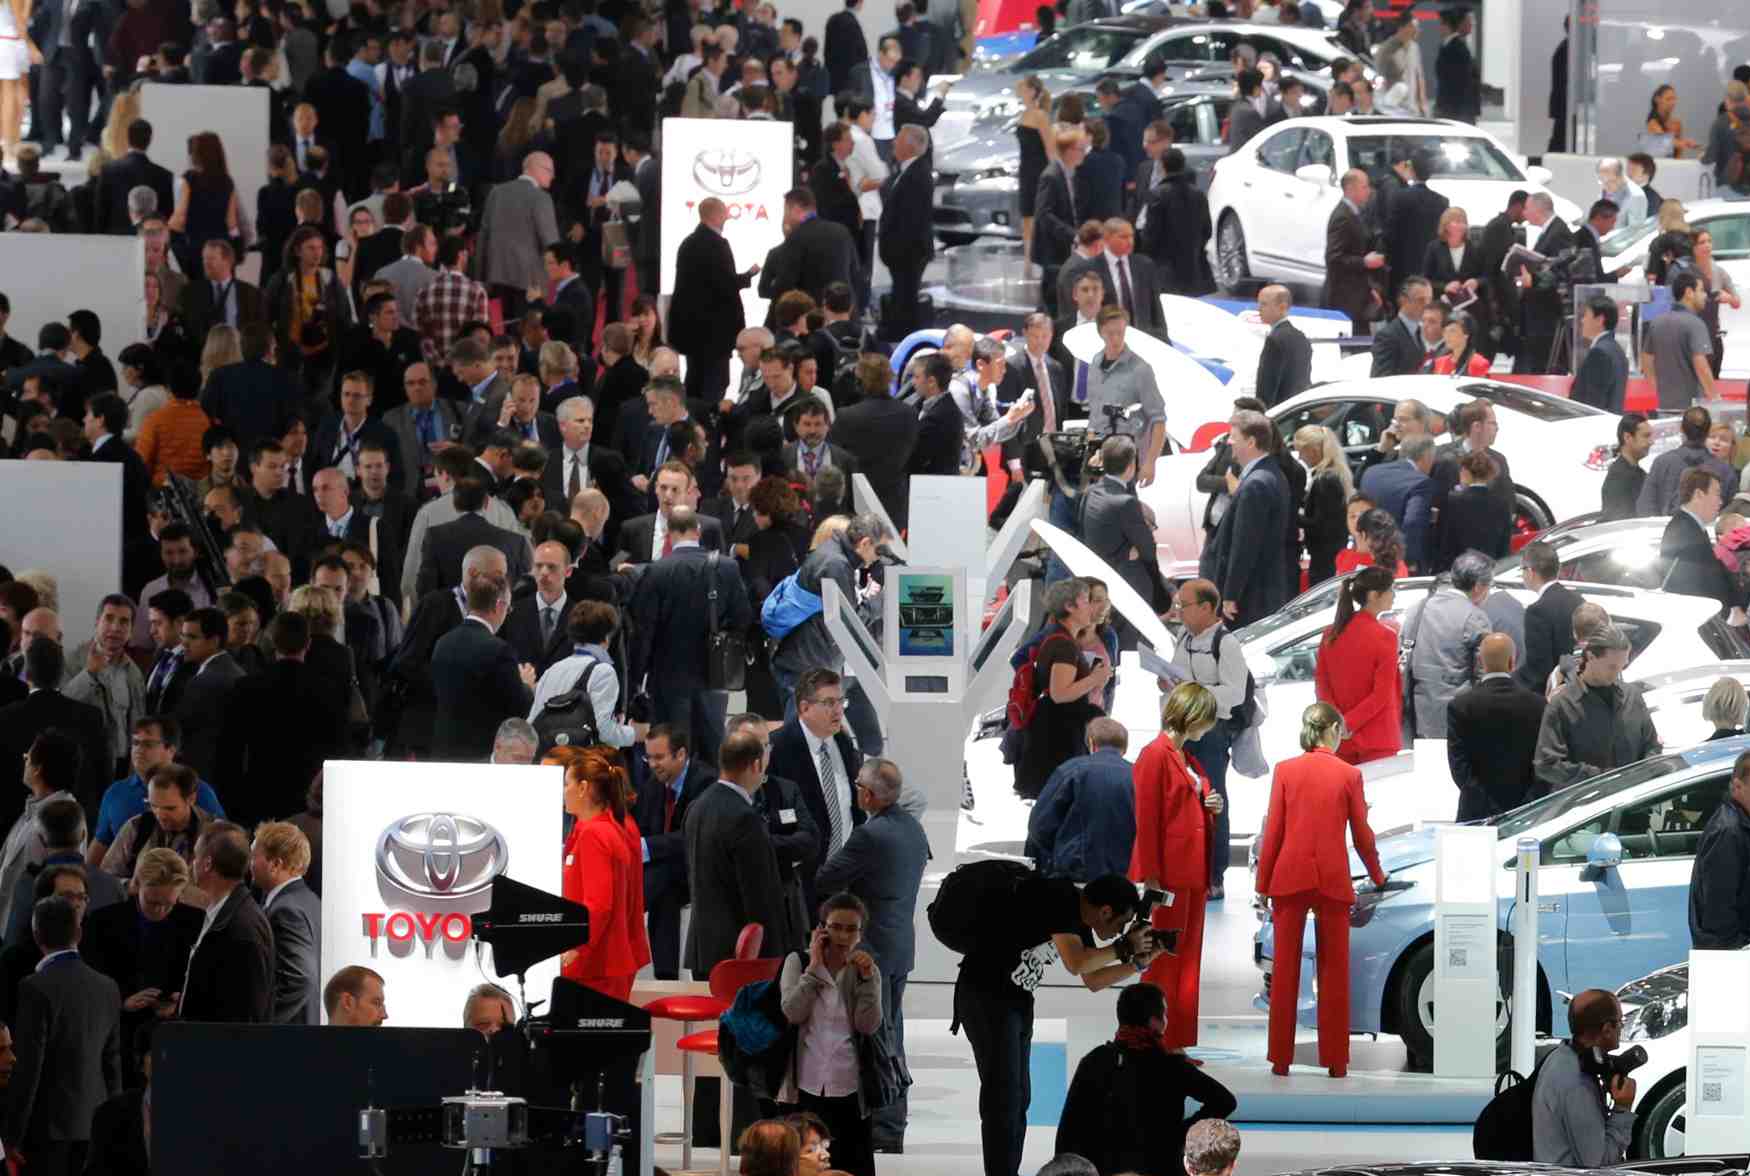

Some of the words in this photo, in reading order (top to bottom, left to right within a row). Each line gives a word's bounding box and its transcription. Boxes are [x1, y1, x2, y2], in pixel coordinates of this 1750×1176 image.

[685, 201, 769, 221] TOTA
[518, 913, 564, 923] SHURE
[361, 912, 471, 942] TOYO
[577, 1018, 625, 1028] SHURE
